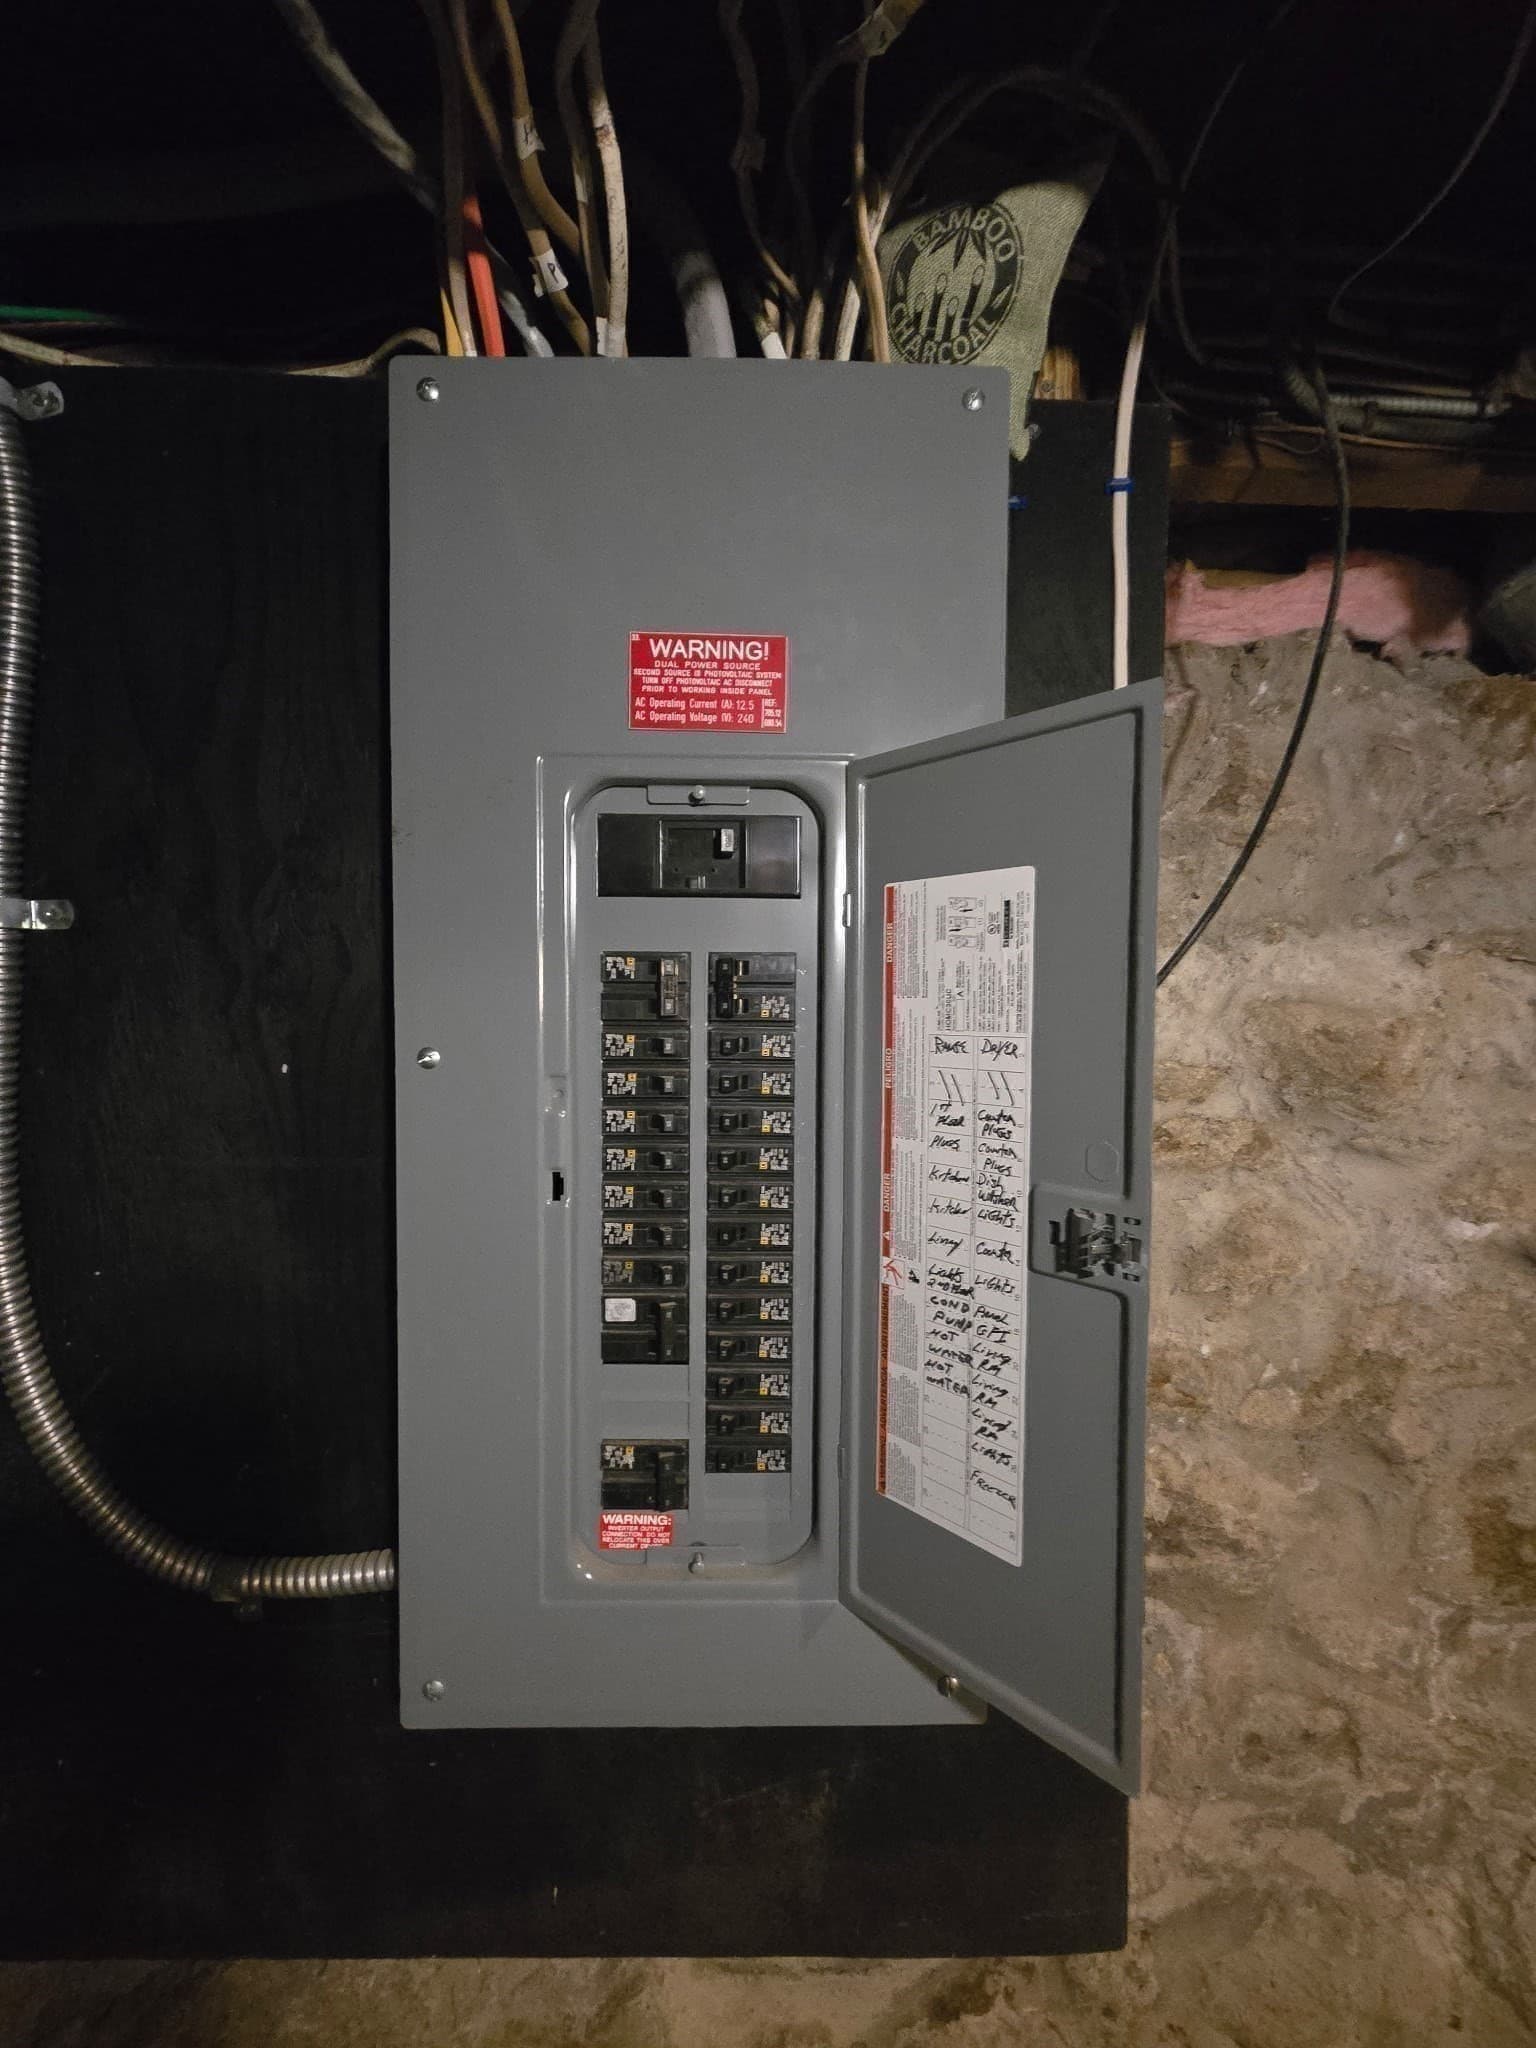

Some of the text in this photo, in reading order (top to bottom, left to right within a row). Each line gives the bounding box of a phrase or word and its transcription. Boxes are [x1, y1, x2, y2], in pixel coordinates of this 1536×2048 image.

[912, 207, 1016, 263] BAMBOO
[892, 303, 997, 365] CHARCOAL
[649, 638, 769, 660] WARNING!
[654, 660, 761, 670] DUAL POWER SOURCE
[633, 668, 661, 676] SECOND
[664, 669, 691, 677] SOURCE
[704, 670, 753, 679] PHOTOVOLTAIC
[756, 672, 782, 680] SYSTEM
[661, 677, 673, 685] OFF
[676, 678, 721, 686] PHOTOVOLTAIC
[735, 679, 773, 687] DISCONNECT
[641, 685, 665, 693] PRIOR
[681, 686, 716, 694] WORKING
[720, 687, 745, 695] INSIDE
[748, 688, 773, 696] PANEL
[635, 697, 646, 707] AC
[649, 697, 686, 710] Operating
[689, 698, 717, 709] Current
[635, 711, 646, 721] AC
[649, 711, 686, 724] Operating
[689, 712, 718, 723] Voltage
[737, 713, 754, 724] 240
[886, 922, 894, 963] DANGER
[885, 1048, 893, 1089] PELIGRO
[883, 1173, 891, 1213] DANGER
[602, 1513, 672, 1526] WARNING:
